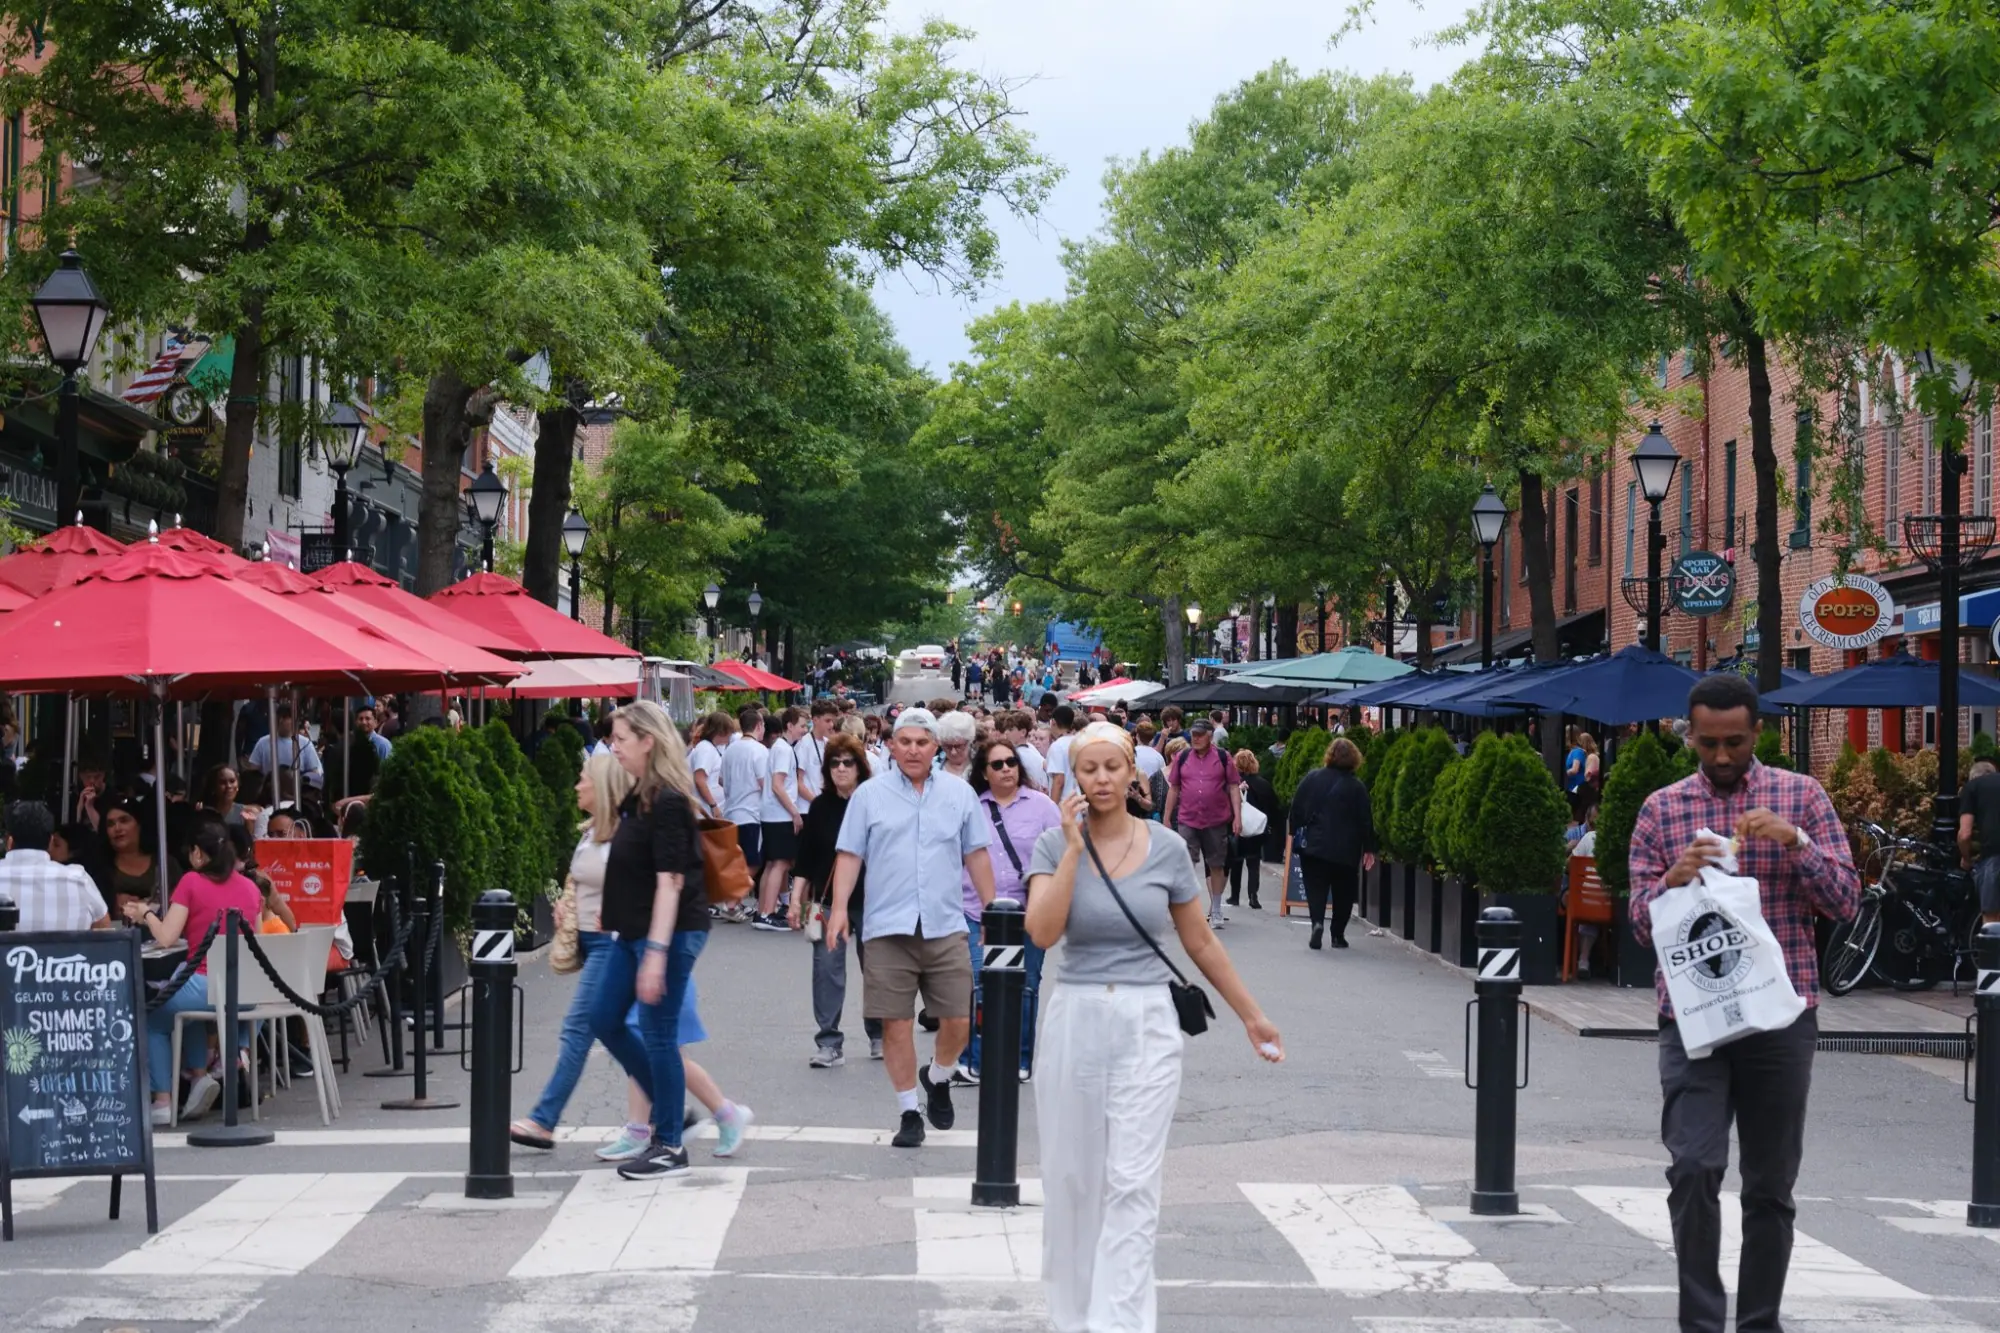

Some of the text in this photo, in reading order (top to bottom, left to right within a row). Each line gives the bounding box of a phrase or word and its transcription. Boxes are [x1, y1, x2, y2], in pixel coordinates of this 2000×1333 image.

[13, 469, 58, 511] CREAM
[1683, 559, 1717, 568] SPORTS
[1690, 566, 1710, 574] BAR
[1808, 581, 1828, 601] OLD
[1683, 600, 1723, 608] UPSTAIRS
[1818, 603, 1876, 617] POP'S
[1801, 610, 1892, 649] ICE CREAM COMPANY
[6, 945, 127, 991] Pitango
[15, 989, 118, 1003] GELATO & COFFEE
[28, 1007, 107, 1034] SUMMER
[47, 1032, 94, 1053] HOURS
[40, 1071, 118, 1094] OPEN LATE
